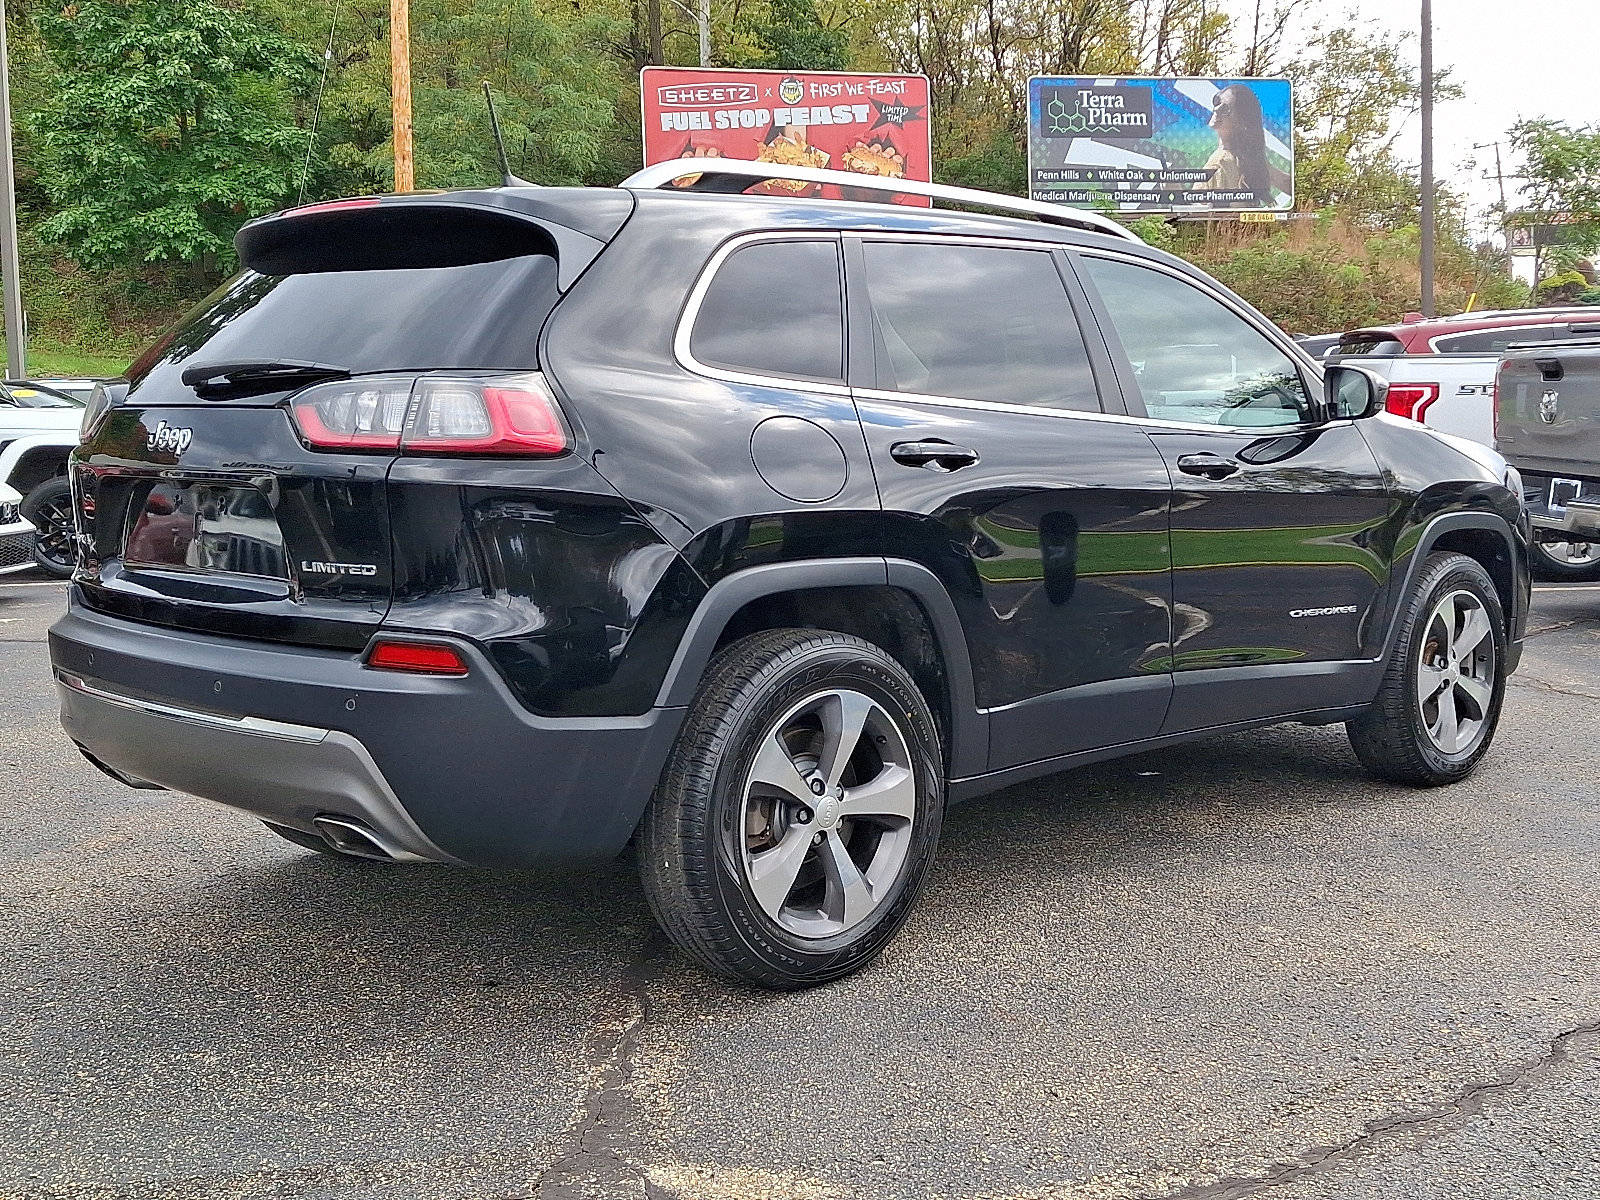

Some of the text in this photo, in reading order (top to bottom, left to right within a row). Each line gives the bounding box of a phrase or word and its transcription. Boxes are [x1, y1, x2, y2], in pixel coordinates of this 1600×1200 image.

[665, 87, 751, 102] SHEETZ
[810, 82, 843, 99] FIRST
[845, 81, 864, 96] WE
[865, 79, 906, 95] FEAST
[1077, 90, 1124, 107] Terra
[660, 104, 870, 131] FUEL STOP FEAST
[882, 105, 909, 115] LIMITED
[887, 113, 903, 122] TIME
[1087, 108, 1147, 125] Pharm
[1037, 170, 1206, 180] Penn Hills White Oak Uniontown
[1033, 191, 1067, 200] Medical
[1115, 192, 1160, 202] Dispensary
[1182, 191, 1254, 201] Terra-Pharm.com
[147, 420, 193, 457] Jeep
[301, 560, 377, 576] LIMITED
[1289, 604, 1358, 618] CHEROKEE
